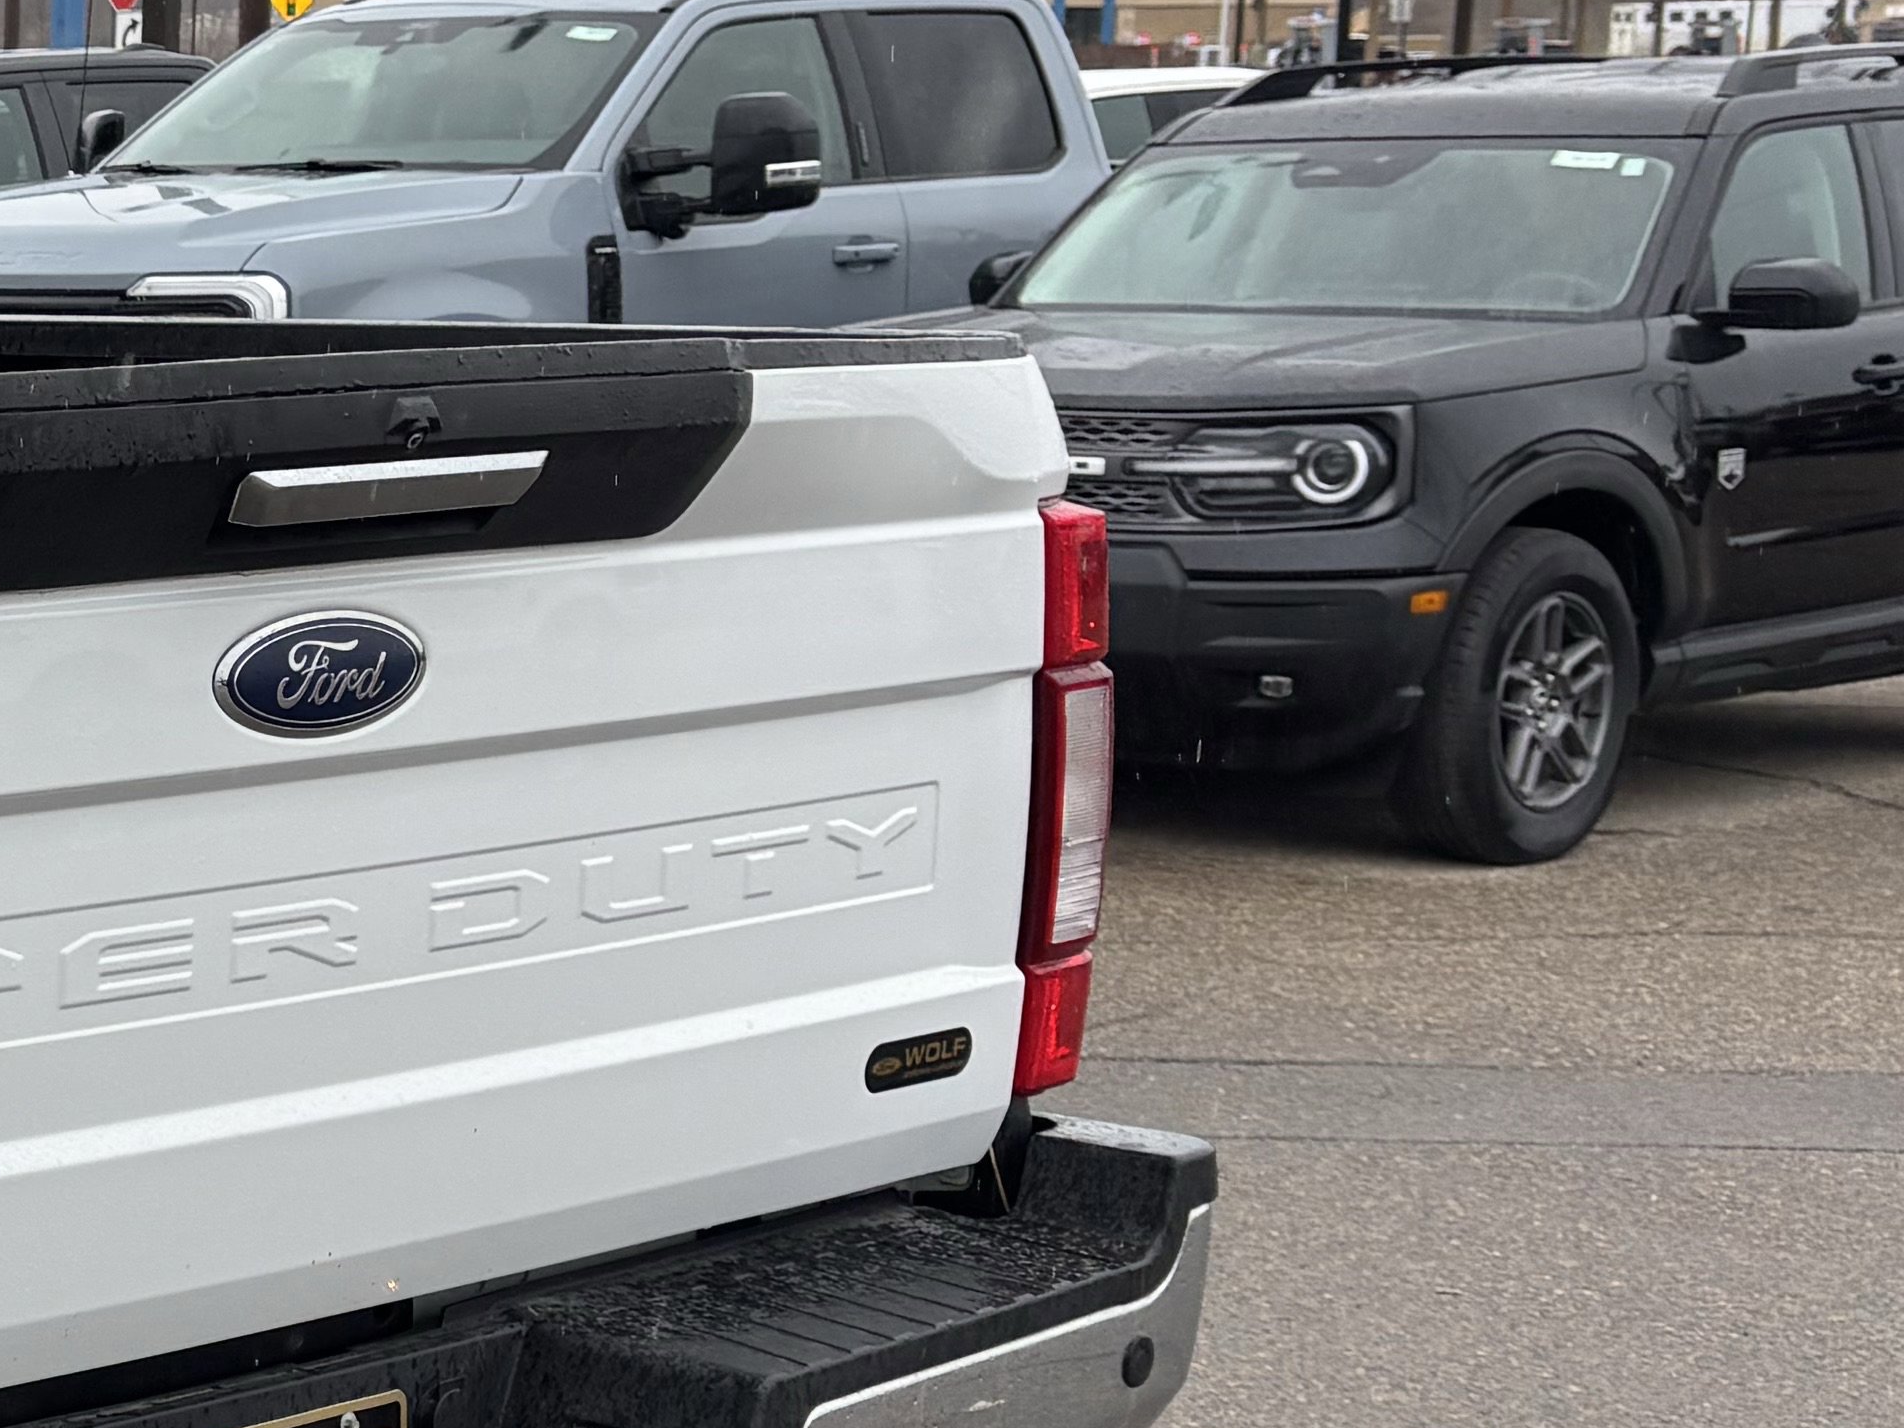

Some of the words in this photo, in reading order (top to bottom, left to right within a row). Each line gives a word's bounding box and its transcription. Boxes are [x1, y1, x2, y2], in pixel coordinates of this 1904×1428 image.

[276, 638, 387, 710] Ford
[429, 805, 920, 956] DUTY
[905, 1036, 967, 1068] WOLF
